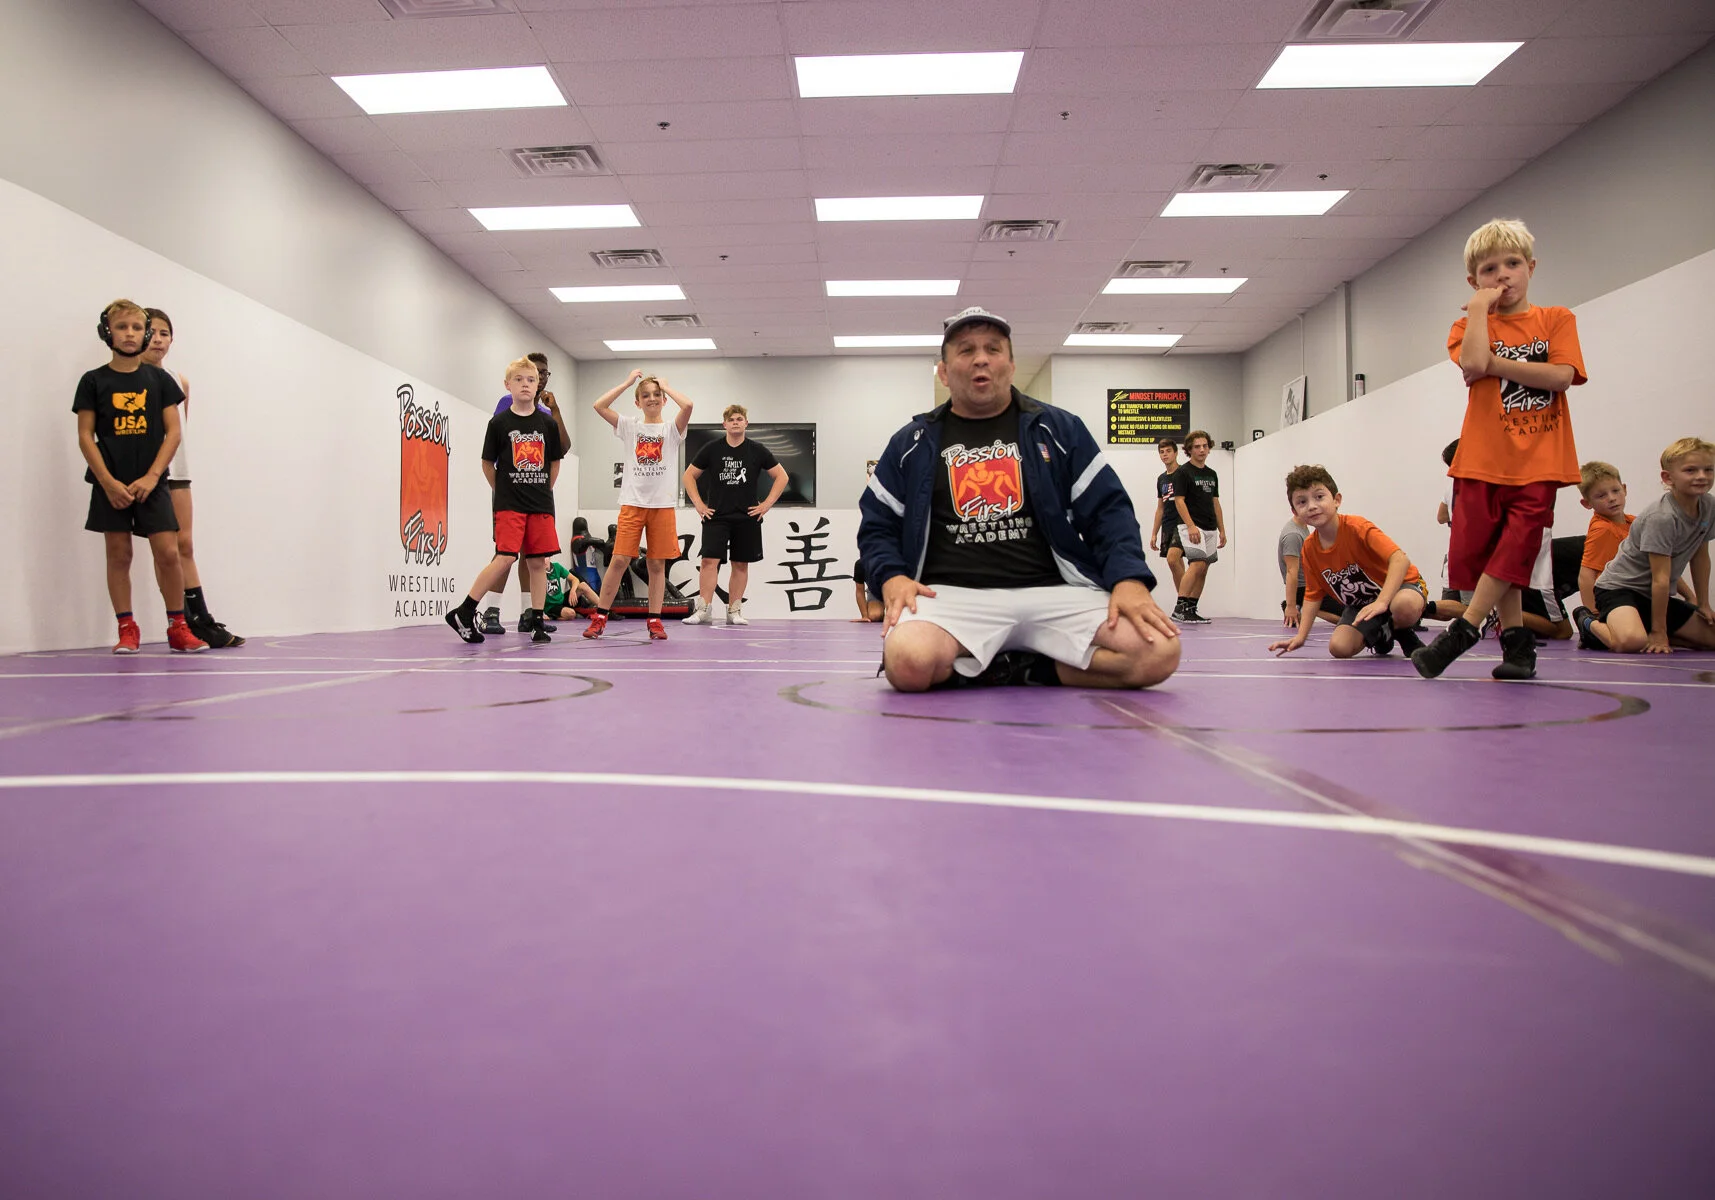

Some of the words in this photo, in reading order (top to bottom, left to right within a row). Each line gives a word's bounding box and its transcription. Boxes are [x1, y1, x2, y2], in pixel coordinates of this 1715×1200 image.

[1129, 392, 1154, 400] MINDSET
[1155, 392, 1187, 400] PRINCIPLES
[114, 415, 147, 430] USA
[397, 383, 451, 456] Passion
[508, 430, 545, 444] Passion
[941, 439, 1023, 468] Passion
[517, 458, 543, 472] First
[725, 460, 743, 468] FAMILY
[960, 495, 1018, 522] First
[945, 517, 1033, 534] WRESTLING
[403, 509, 446, 567] First
[955, 528, 1028, 544] ACADEMY
[389, 574, 455, 593] WRESTLING
[395, 600, 450, 617] ACADEMY
